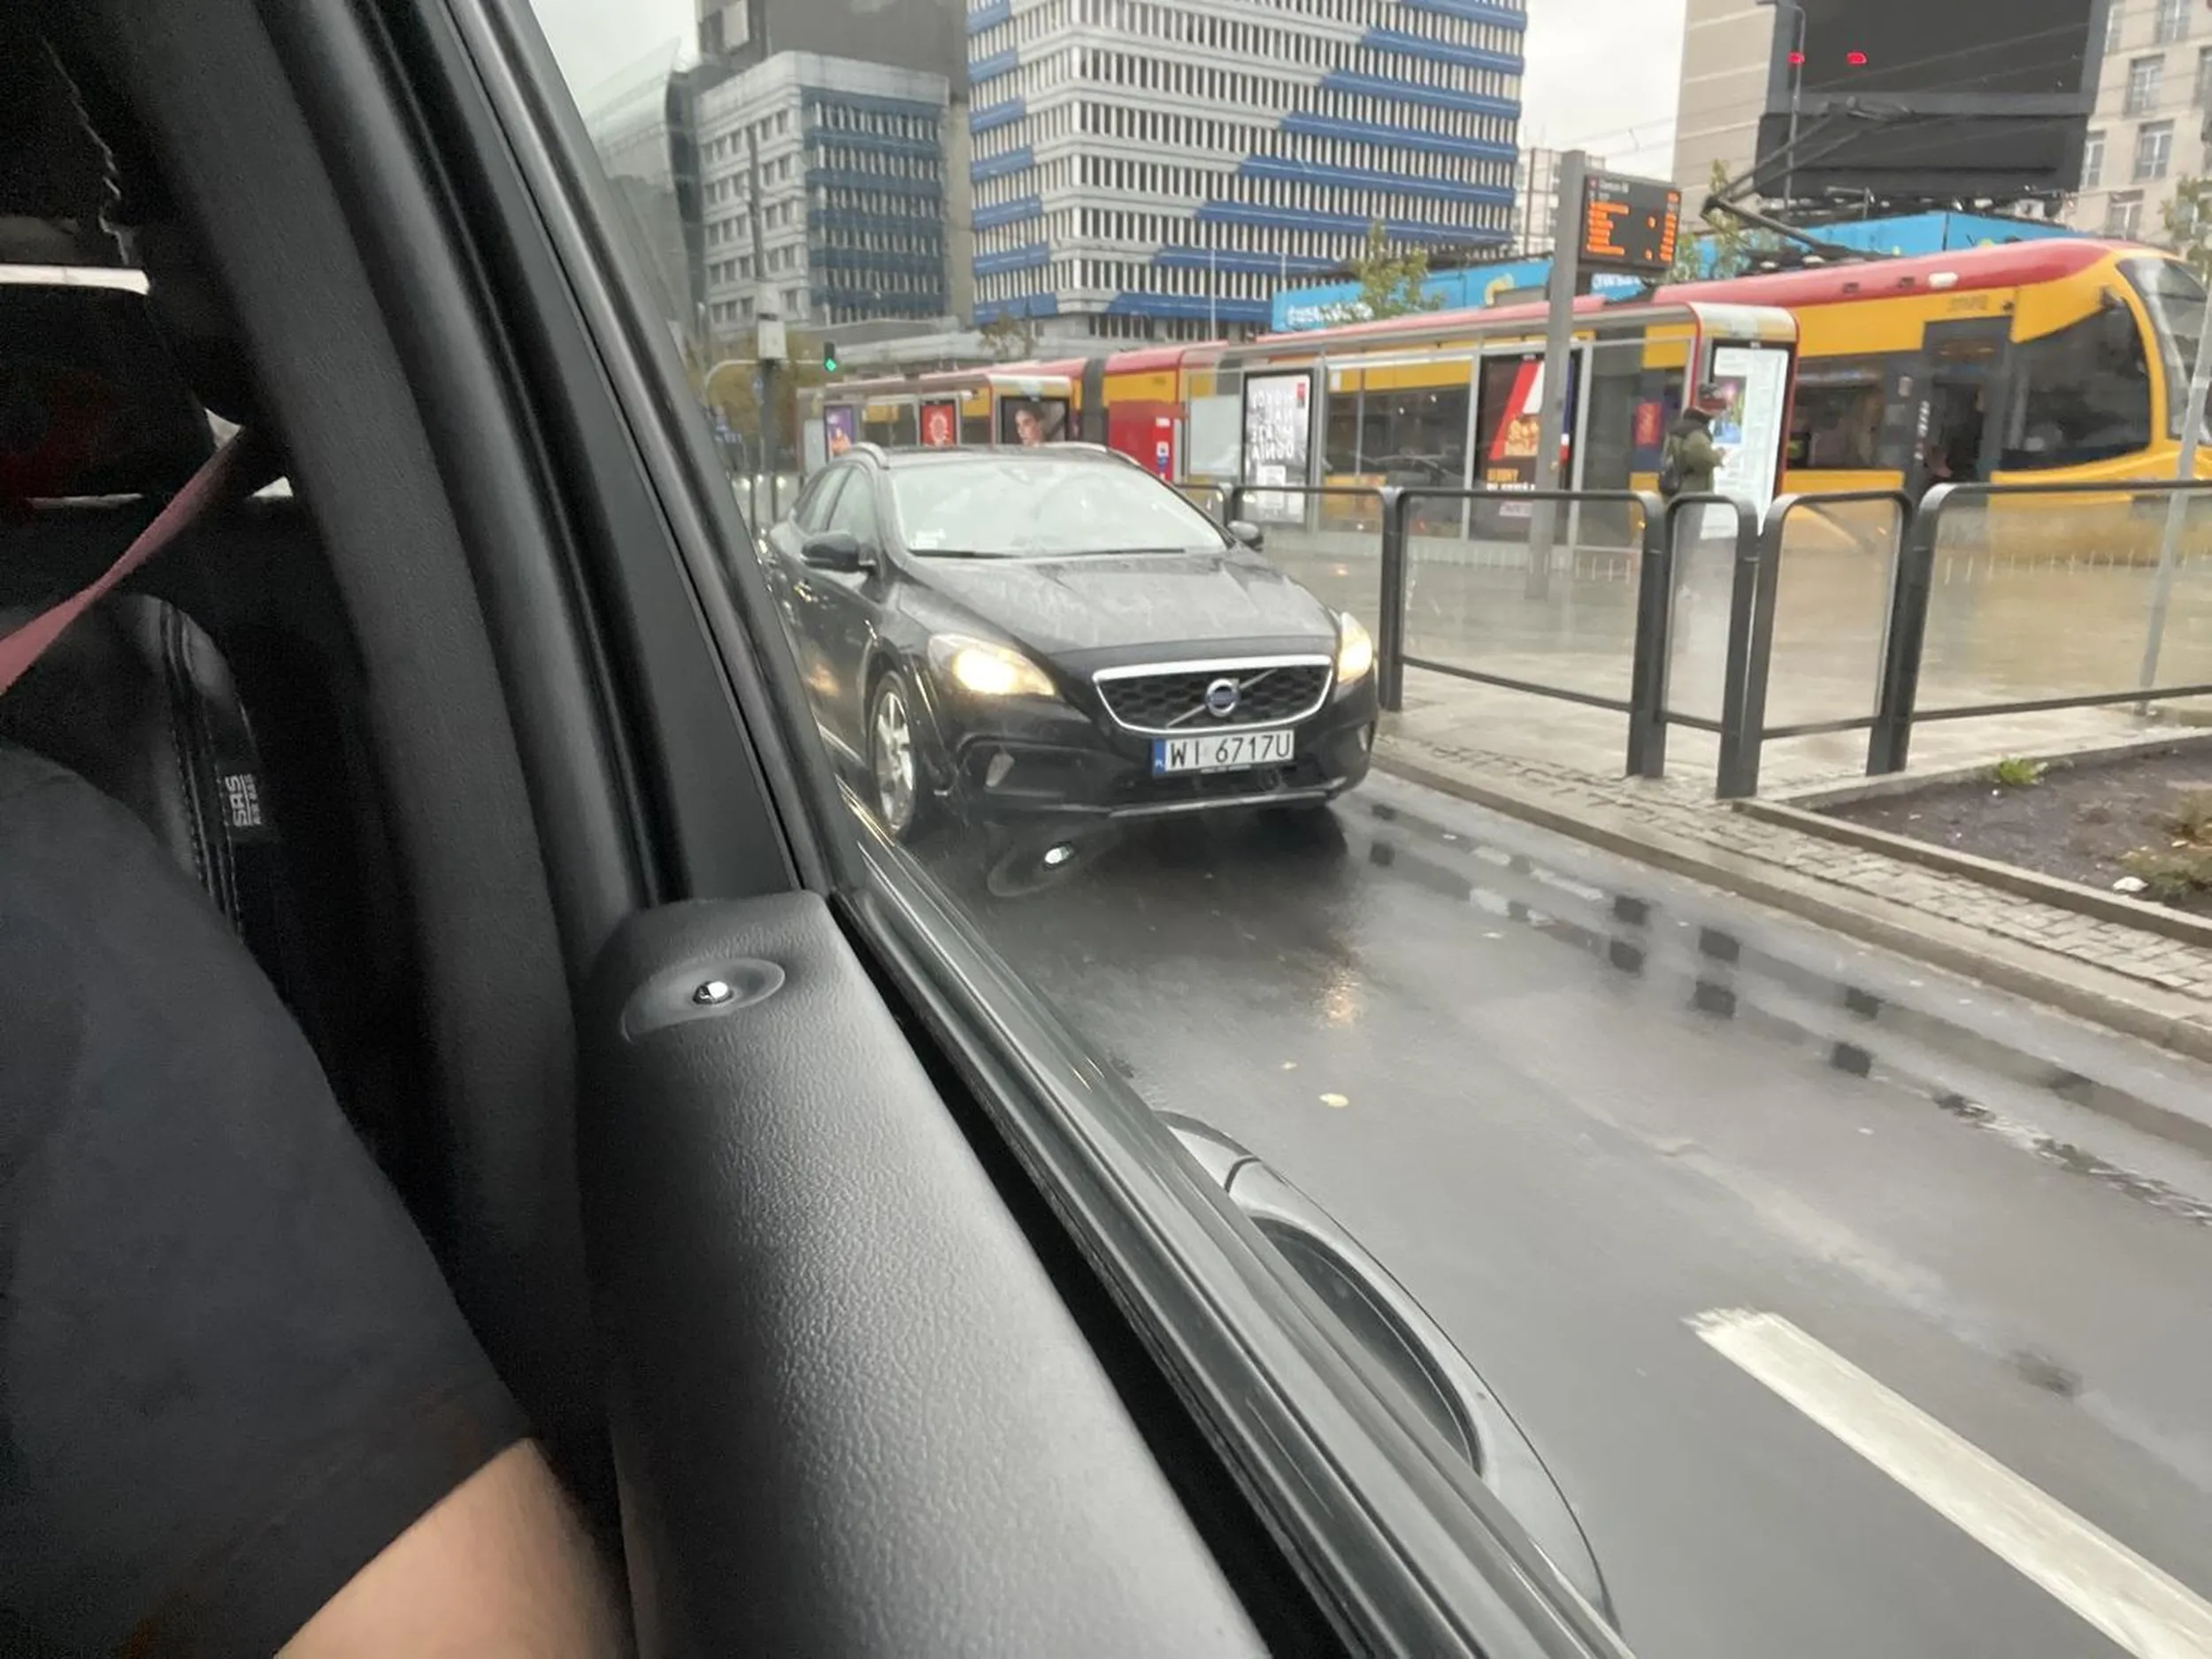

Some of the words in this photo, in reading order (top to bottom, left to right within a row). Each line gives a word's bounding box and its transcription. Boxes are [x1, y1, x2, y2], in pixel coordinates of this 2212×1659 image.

[1171, 740, 1200, 767] WI
[1216, 733, 1291, 764] 6717U
[225, 775, 248, 827] SRS
